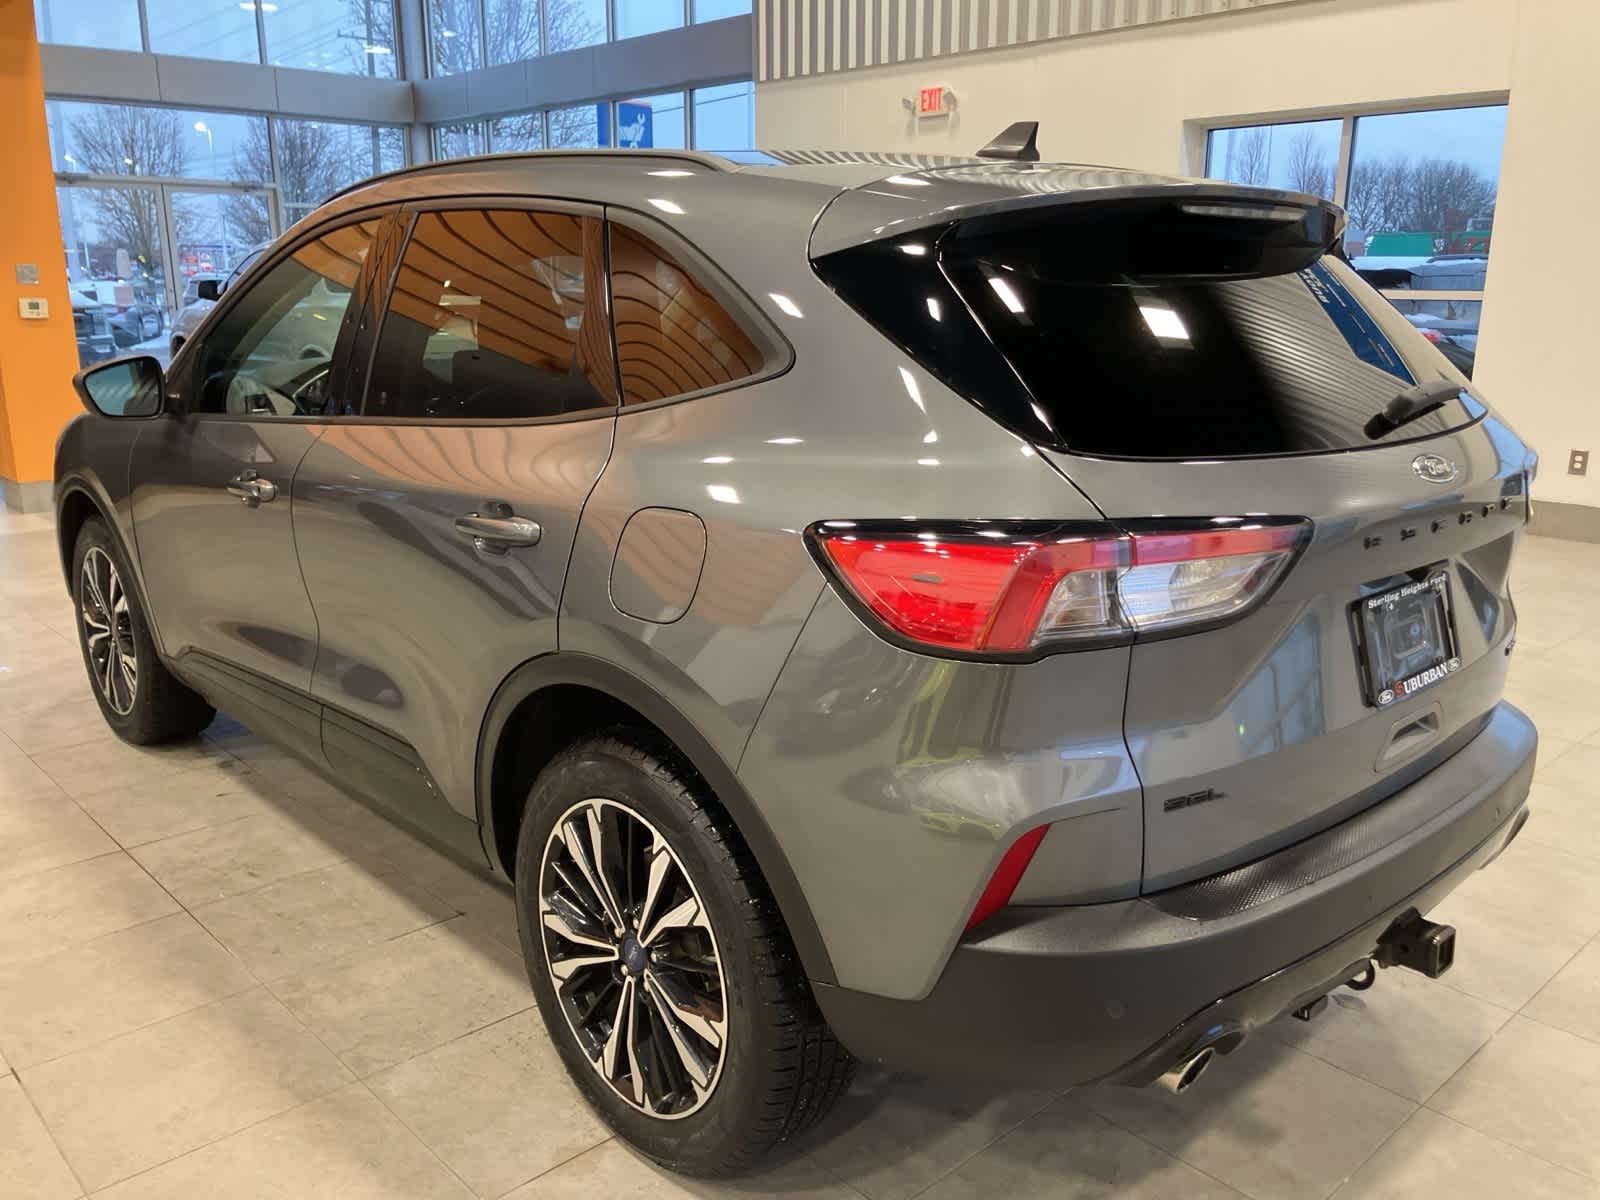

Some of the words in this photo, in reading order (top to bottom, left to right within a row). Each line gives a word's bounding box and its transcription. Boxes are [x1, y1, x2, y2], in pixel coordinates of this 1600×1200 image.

[920, 87, 944, 112] EXIT
[1367, 592, 1400, 609] Sterling
[1400, 581, 1429, 597] Heights
